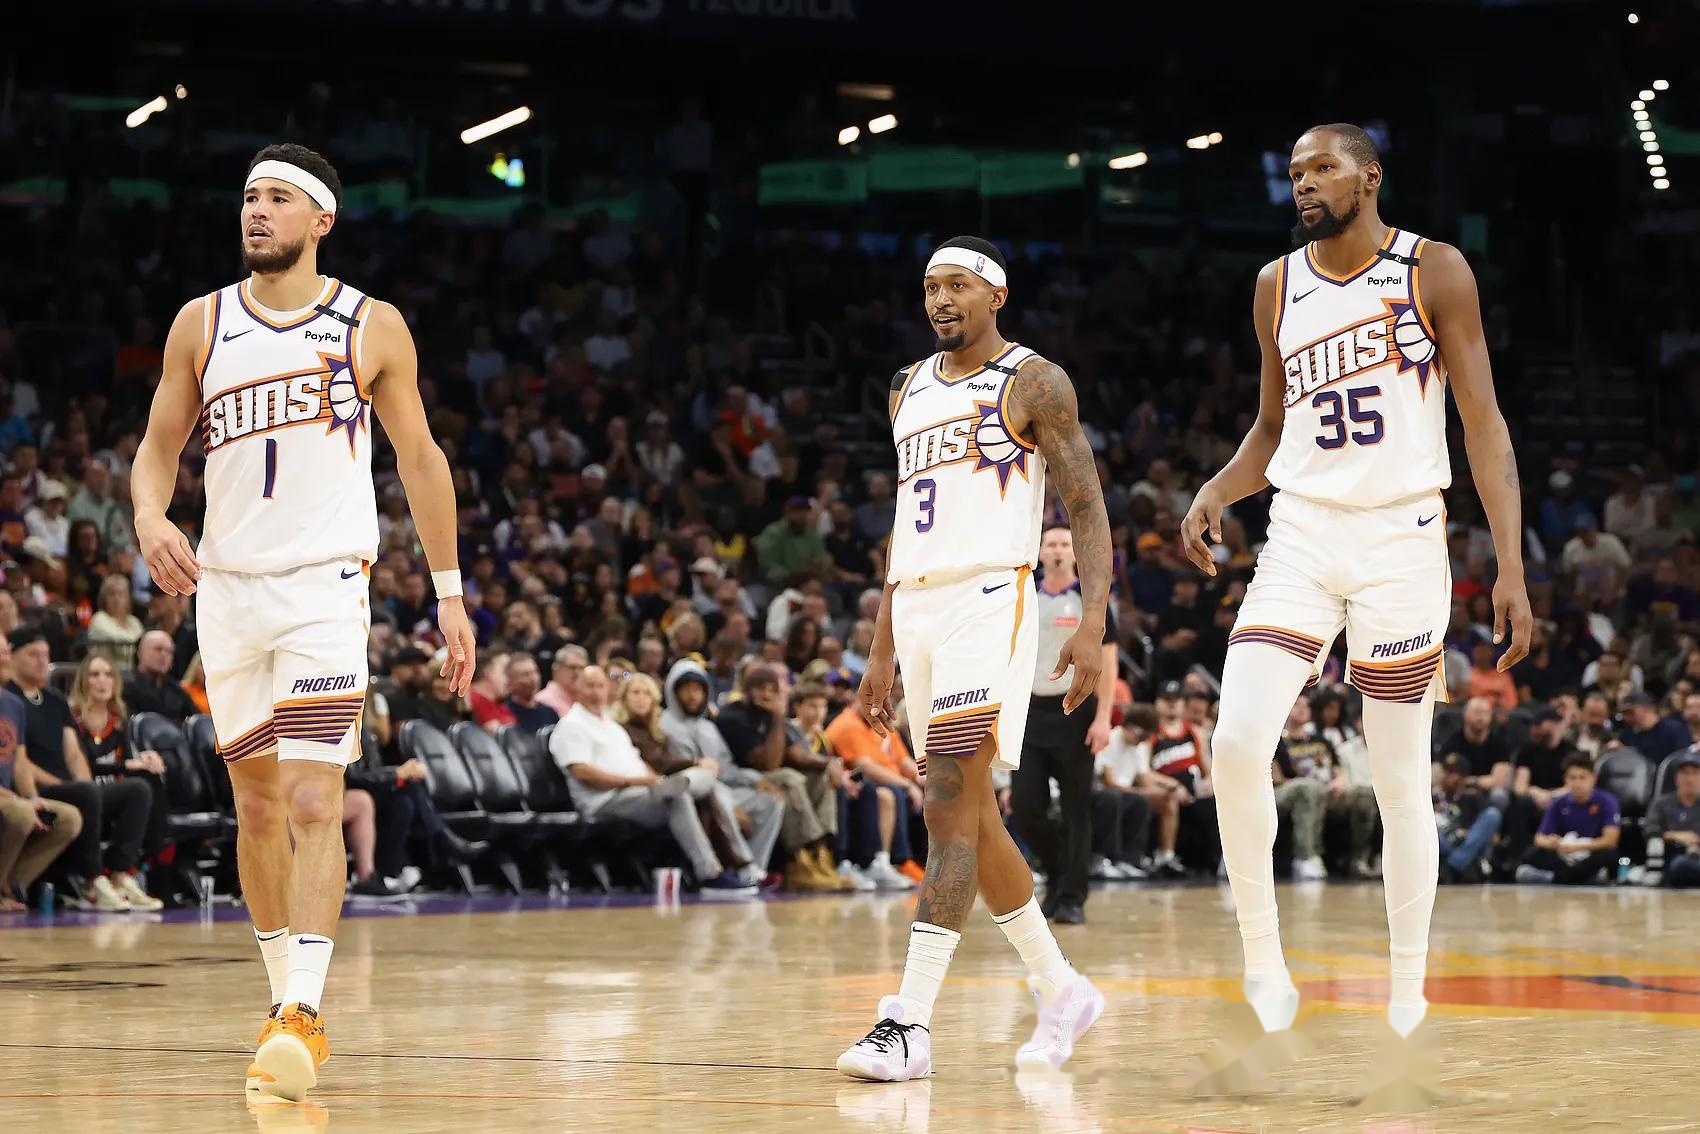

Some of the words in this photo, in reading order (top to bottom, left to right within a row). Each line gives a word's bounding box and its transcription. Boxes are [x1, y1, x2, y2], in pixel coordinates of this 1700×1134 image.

[1367, 277, 1402, 287] PayPal
[305, 331, 341, 343] PayPal
[967, 382, 997, 392] PayPal
[209, 375, 322, 448] SUNS
[1312, 385, 1385, 450] 35
[898, 421, 972, 482] UNS
[263, 438, 278, 499] 1
[913, 478, 937, 533] 3
[1371, 629, 1433, 658] PHOENIX
[291, 673, 357, 694] PHOENIX
[931, 687, 990, 713] PHOENIX
